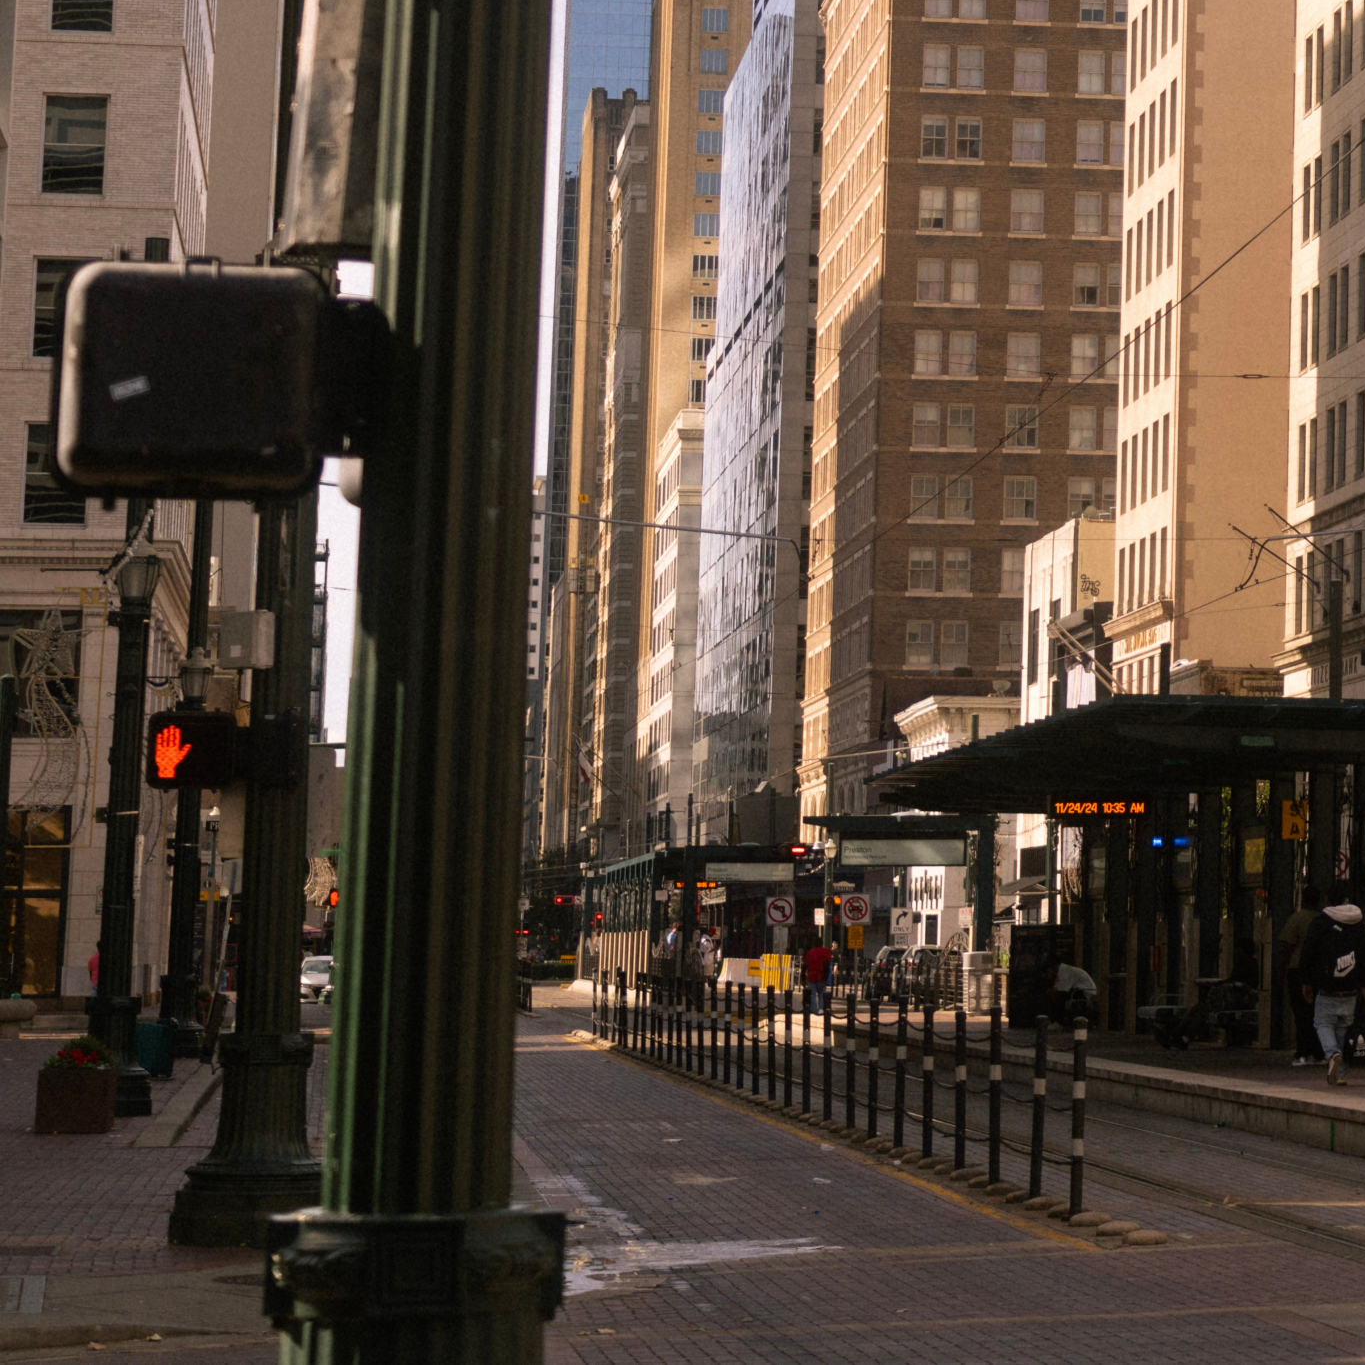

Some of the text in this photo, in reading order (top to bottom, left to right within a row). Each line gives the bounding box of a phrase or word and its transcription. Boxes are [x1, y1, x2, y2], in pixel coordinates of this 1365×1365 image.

[1055, 802, 1145, 814] 11/24/24 10:35 AM
